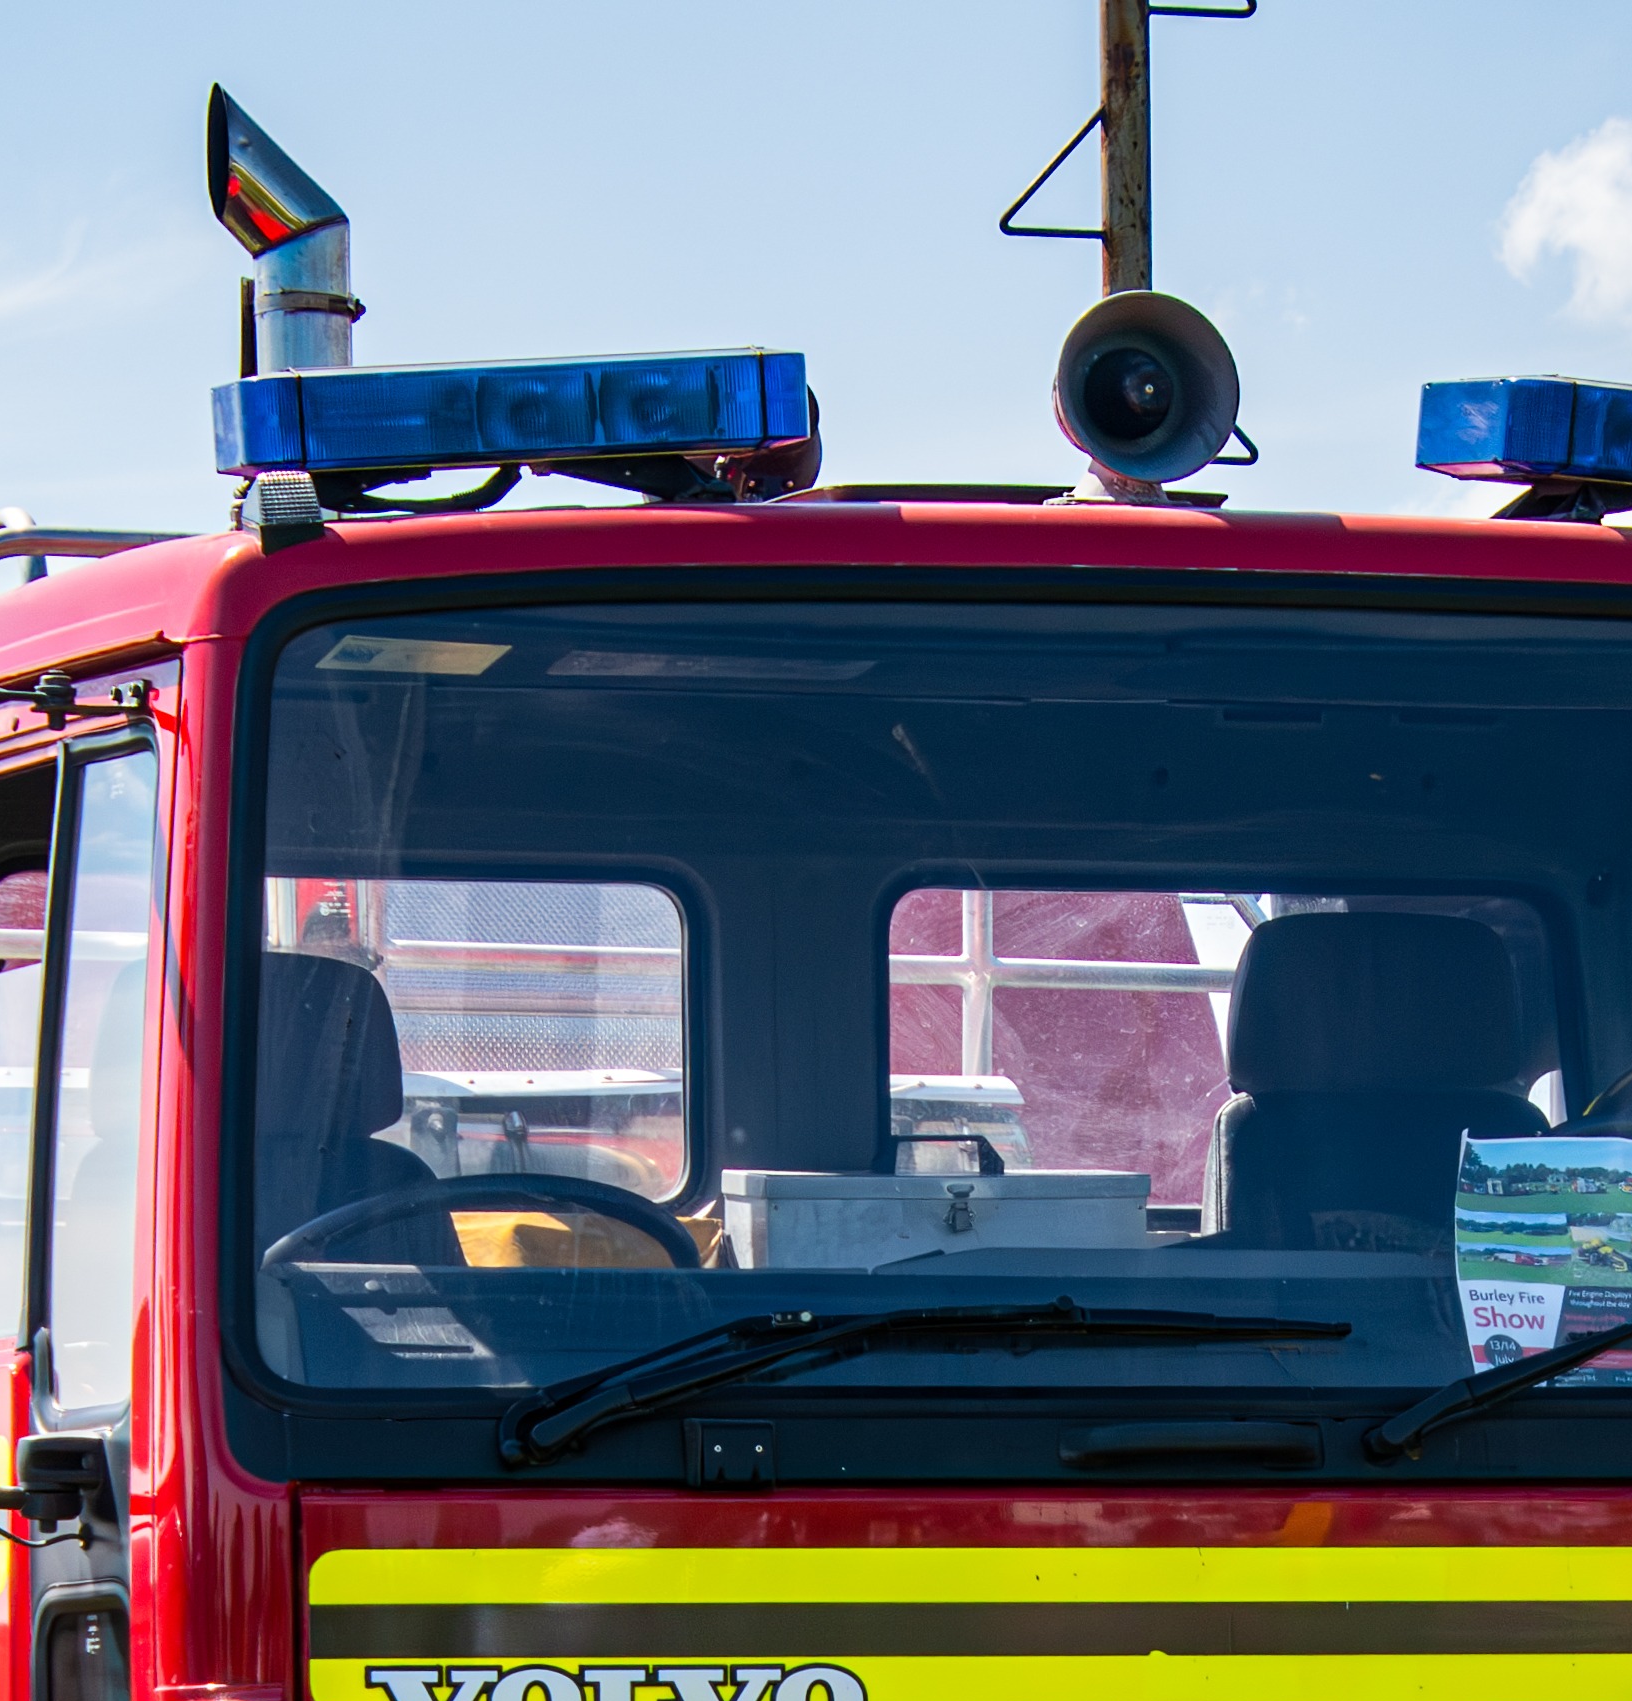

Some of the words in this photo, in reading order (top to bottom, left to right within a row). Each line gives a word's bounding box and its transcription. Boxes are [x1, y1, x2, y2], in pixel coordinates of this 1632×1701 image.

[1469, 1289, 1515, 1306] Burley
[1519, 1292, 1545, 1304] Fire
[1473, 1305, 1545, 1330] Show
[1490, 1340, 1516, 1351] 13/14
